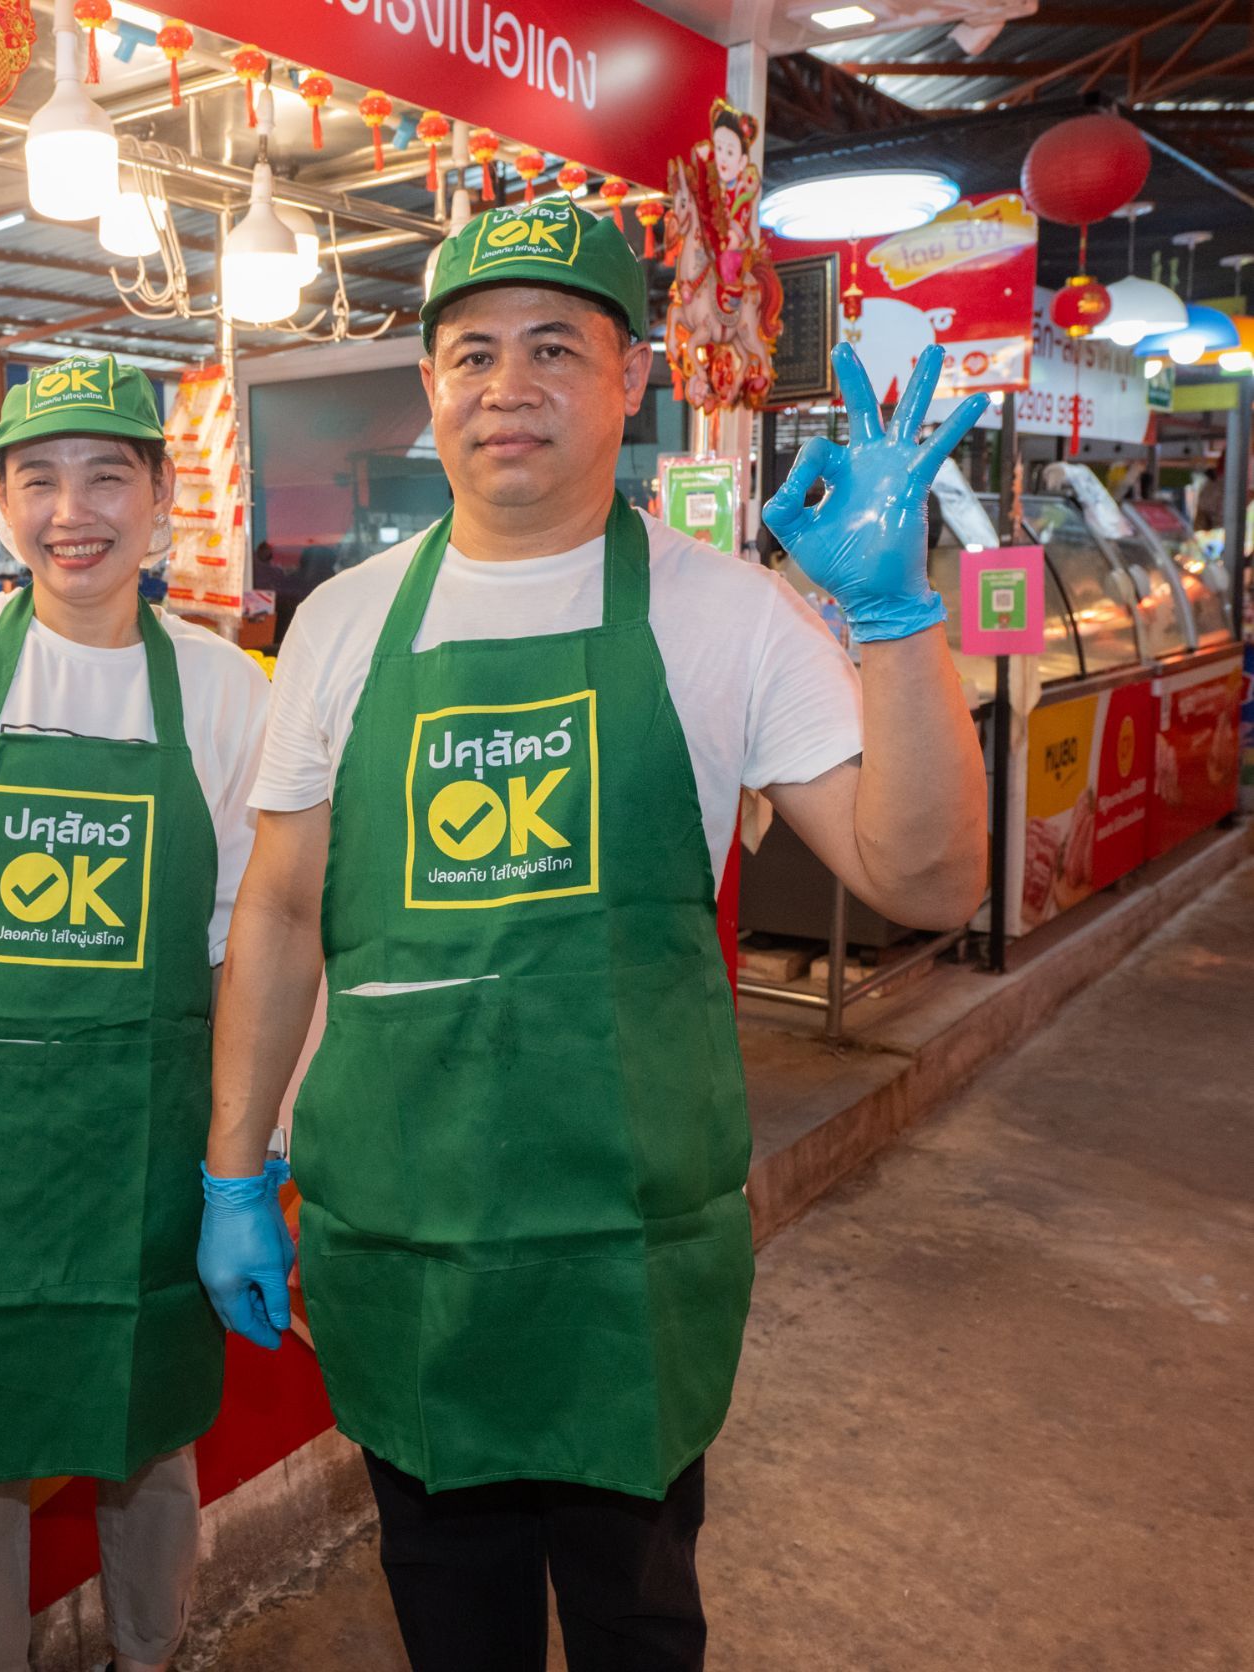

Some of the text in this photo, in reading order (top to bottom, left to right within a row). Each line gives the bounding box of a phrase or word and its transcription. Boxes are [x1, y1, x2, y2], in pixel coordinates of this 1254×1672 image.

[487, 219, 569, 253] OK
[36, 369, 102, 397] OK
[428, 716, 573, 780] ปศุสัตว์
[4, 807, 133, 854] ปศุสัตว์
[428, 767, 572, 861] OK
[0, 851, 129, 928] OK
[428, 856, 573, 884] ปลอดภัย ใส่ใจผู้บริโภค
[51, 927, 125, 949] ใส่ใจผู้บริโภค
